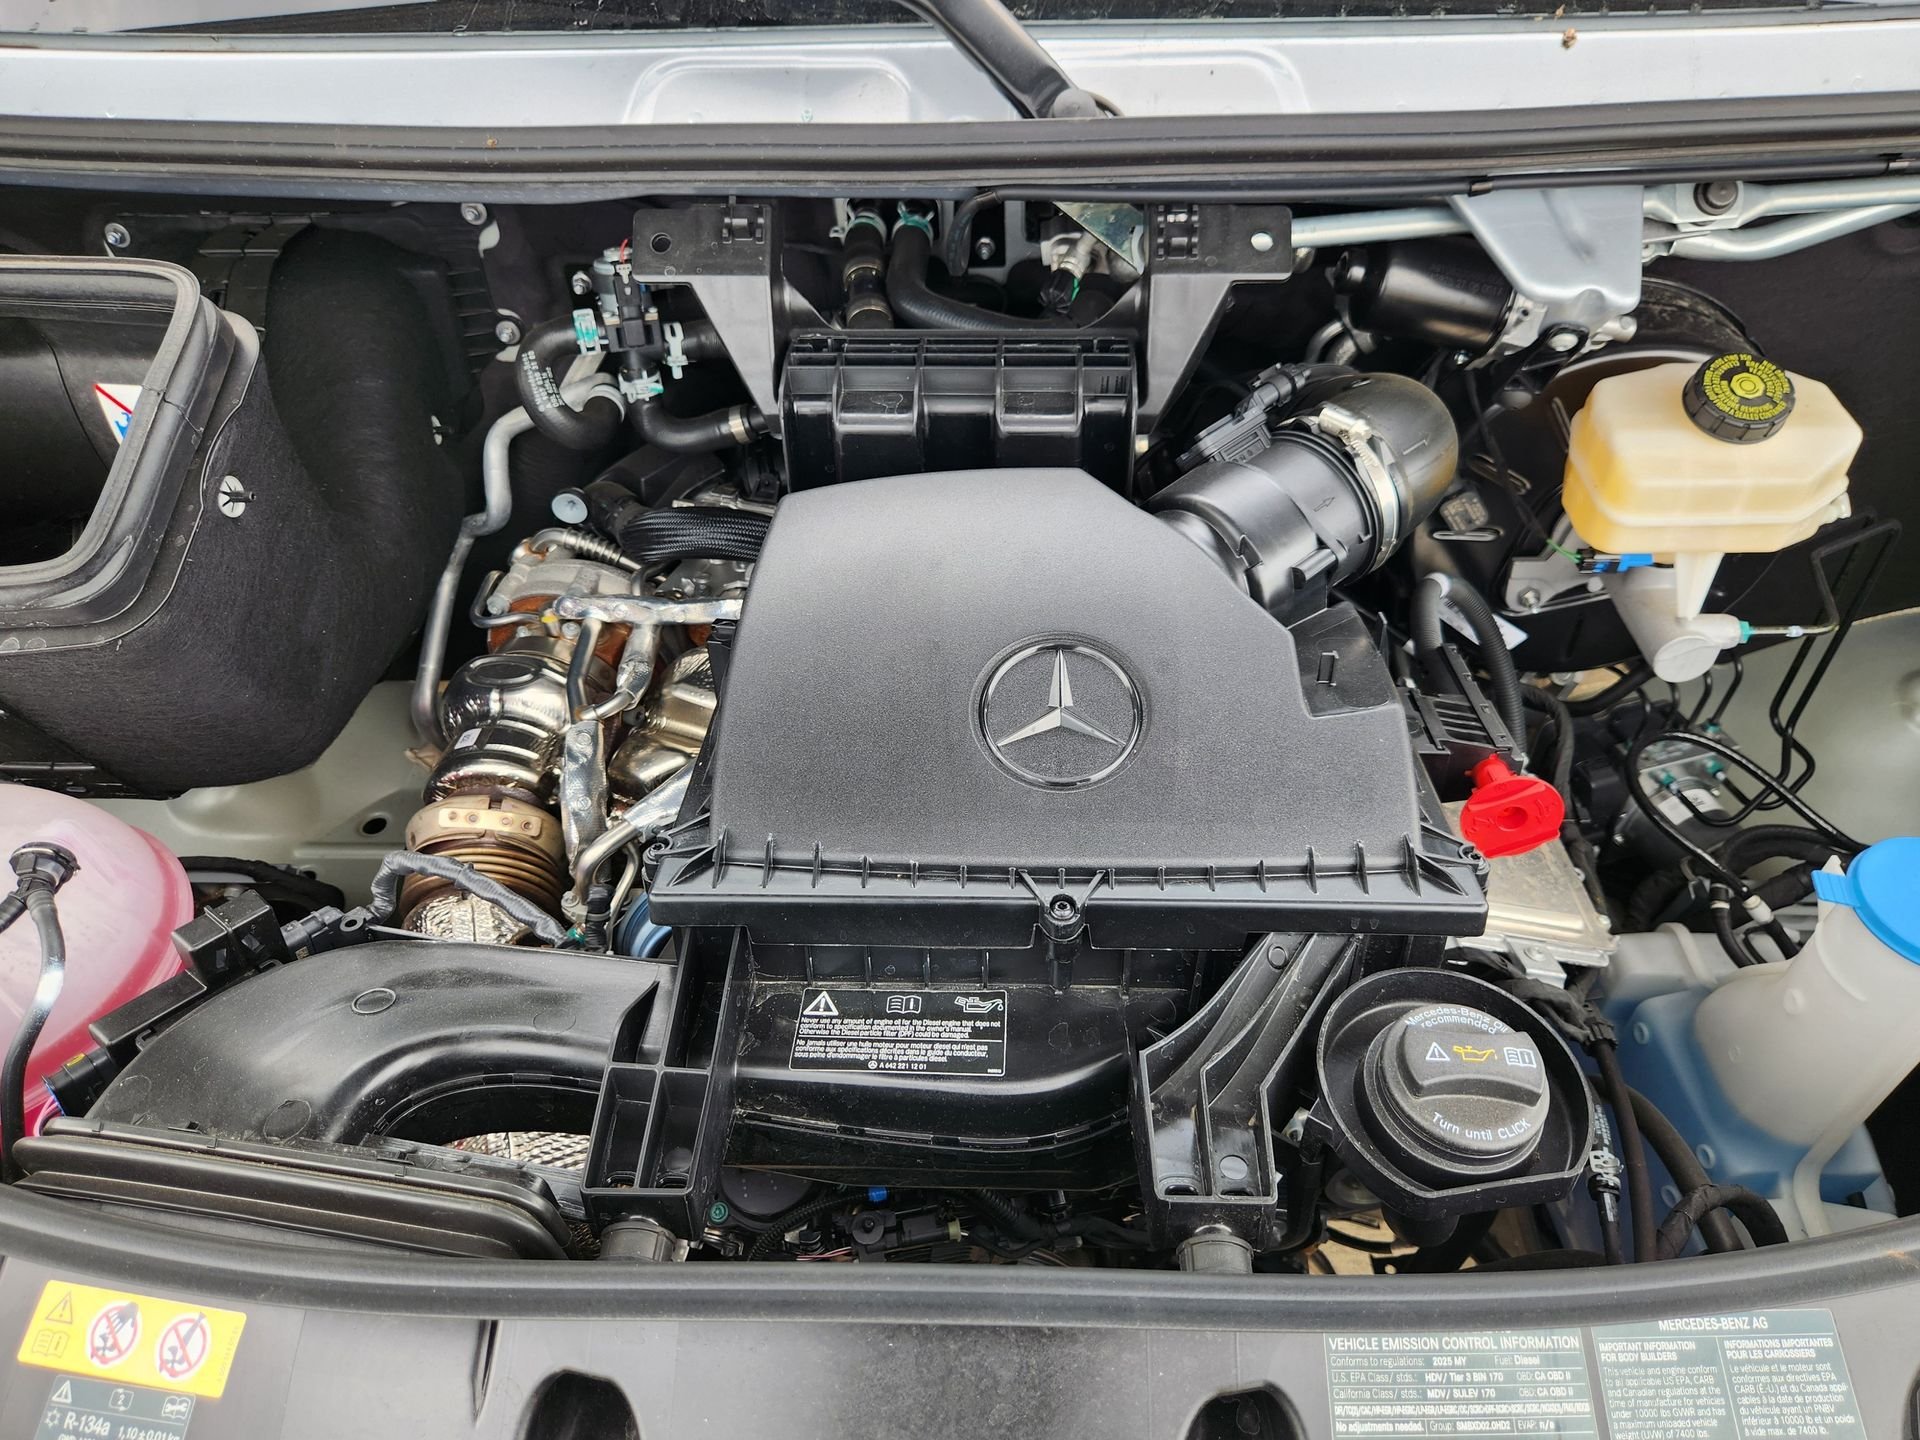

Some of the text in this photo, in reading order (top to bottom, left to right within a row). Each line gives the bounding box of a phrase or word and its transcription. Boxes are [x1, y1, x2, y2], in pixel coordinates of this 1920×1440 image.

[942, 1020, 960, 1028] engine
[1404, 1007, 1509, 1033] Mercedes-Benz Oil
[1421, 1015, 1496, 1034] recommended
[1432, 1112, 1531, 1141] Turn until CLICK
[1658, 1317, 1768, 1331] MERCEDES-BENZ AG
[1329, 1336, 1580, 1350] VEHICLE EMISSION CONTROL INFORMATION
[1599, 1341, 1696, 1352] IMPORTANT INFORMATION
[1724, 1338, 1833, 1349] INFORMATIONS IMPORTANTES
[1601, 1352, 1677, 1362] FOR BODY BUILDERS
[1726, 1349, 1816, 1359] POUR LES CARROSSIERS
[1330, 1355, 1540, 1368] Conforms to regulations: 2025 MY Fuel: Diesel
[1741, 1364, 1769, 1372] véhicule
[1816, 1362, 1832, 1371] sont
[1603, 1368, 1619, 1376] This
[1621, 1367, 1645, 1375] vehicle
[1662, 1367, 1686, 1376] engine
[1688, 1365, 1718, 1375] conform
[1332, 1373, 1348, 1382] U.S.
[1350, 1373, 1366, 1382] EPA
[1368, 1372, 1393, 1383] Class/
[1425, 1372, 1447, 1384] HDV/
[1449, 1372, 1464, 1381] Tier
[1466, 1373, 1471, 1381] 3
[1473, 1372, 1487, 1381] BIN
[1489, 1372, 1503, 1381] 170
[1516, 1371, 1534, 1380] OBD:
[1535, 1370, 1546, 1380] CA
[1547, 1370, 1564, 1380] OBD
[1663, 1376, 1674, 1385] US
[1676, 1376, 1692, 1385] EPA,
[1693, 1375, 1714, 1384] CARB
[1732, 1373, 1837, 1383] conformes directives EPA
[1333, 1388, 1371, 1399] California
[1372, 1388, 1398, 1400] Class/
[1427, 1388, 1450, 1400] MDV/
[1453, 1388, 1479, 1398] SULEV
[1481, 1388, 1496, 1398] 170
[1519, 1387, 1536, 1396] OBD:
[1537, 1387, 1548, 1396] CA
[1550, 1387, 1567, 1396] OBD
[1607, 1387, 1698, 1398] and Canadian regulations
[1735, 1385, 1755, 1394] CARB
[1800, 1383, 1828, 1392] Canada
[1637, 1397, 1726, 1406] manufacture vehicles
[1737, 1394, 1844, 1404] cables date production
[1611, 1408, 1695, 1418] under 10000 GVWR
[1814, 1404, 1835, 1413] PNBV
[63, 1411, 111, 1436] R-134a
[1620, 1419, 1691, 1430] maximum unloaded
[1742, 1414, 1855, 1426] inférieur 10000 poids
[1336, 1422, 1347, 1431] No
[1349, 1421, 1393, 1434] adjustments
[1395, 1421, 1424, 1432] needed.
[1430, 1420, 1454, 1432] Group:
[1518, 1420, 1538, 1430] EVAP:
[1539, 1419, 1555, 1430] n/a
[1798, 1426, 1817, 1435] 7400
[1615, 1429, 1695, 1440] weight (UVW) 7400
